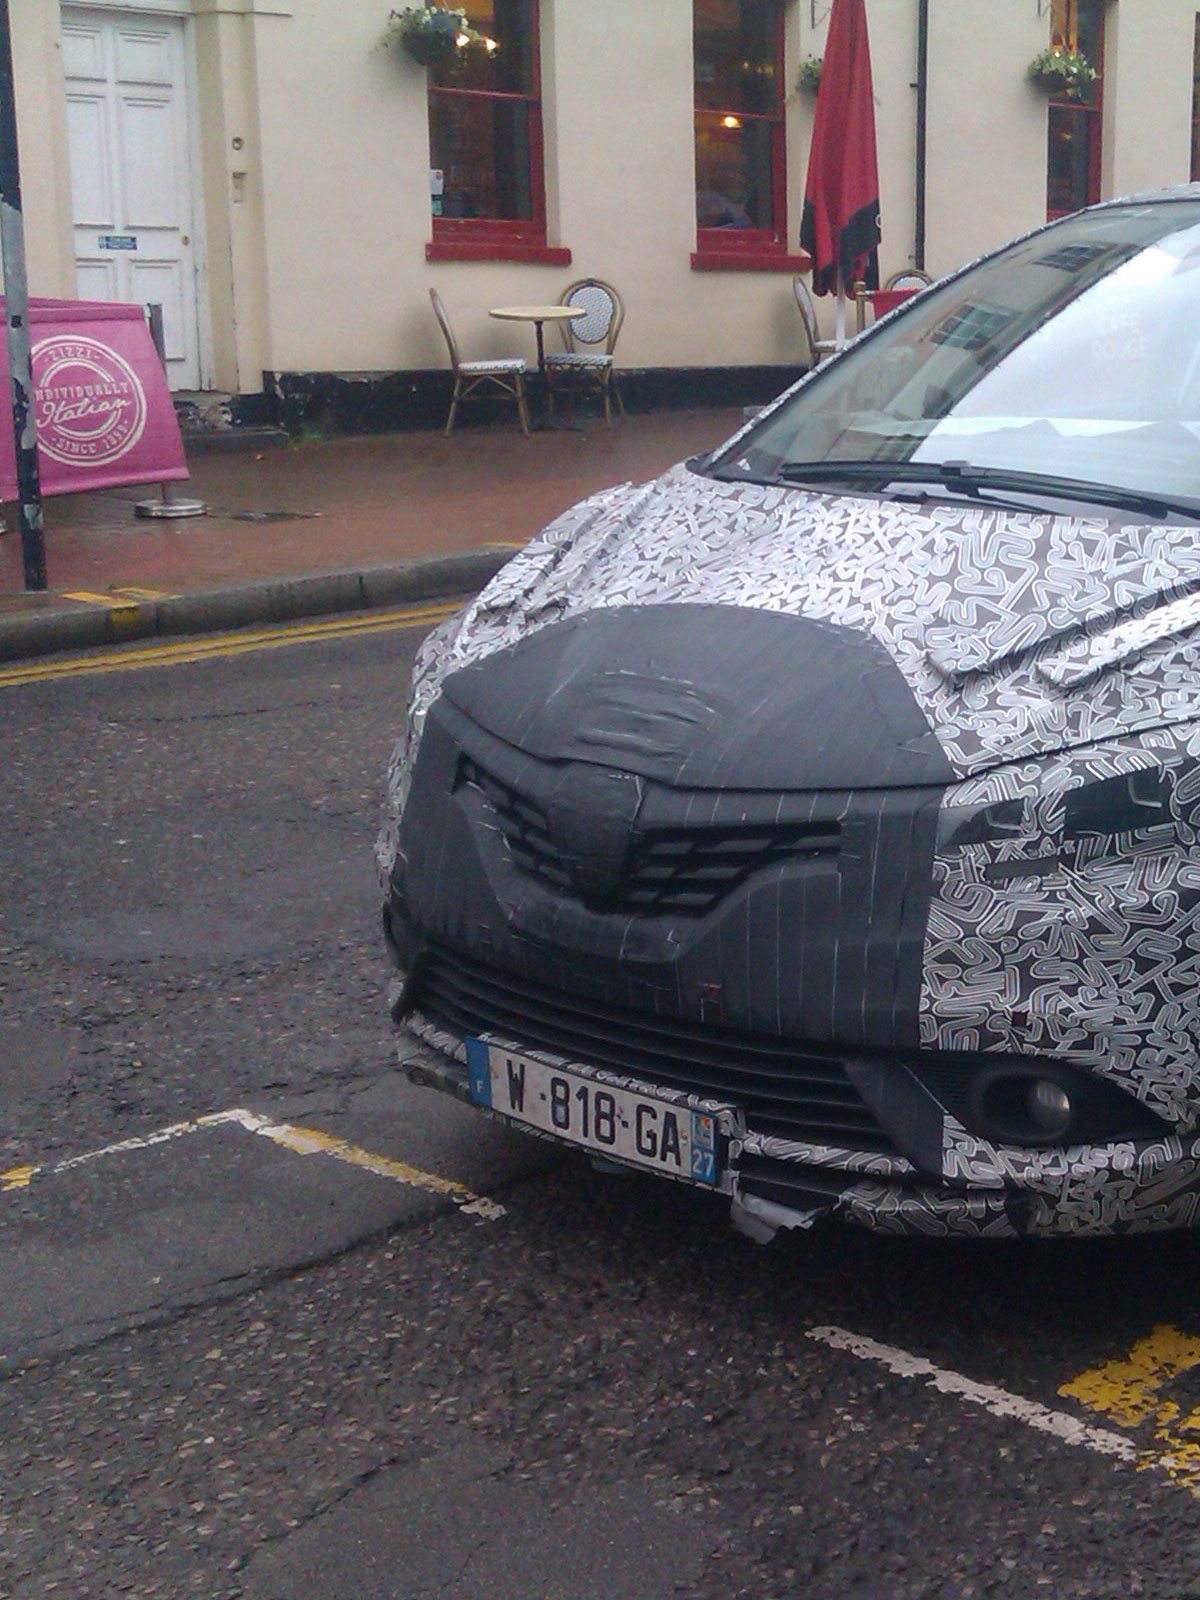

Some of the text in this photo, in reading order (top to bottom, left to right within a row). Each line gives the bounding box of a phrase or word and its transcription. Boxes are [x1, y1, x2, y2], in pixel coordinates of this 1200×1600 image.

[48, 346, 92, 360] ZIZZI
[34, 381, 129, 401] NDIVIDUALLY
[36, 397, 132, 428] Italian
[55, 438, 97, 454] SINCE
[476, 1079, 484, 1093] F
[692, 1149, 715, 1177] 27
